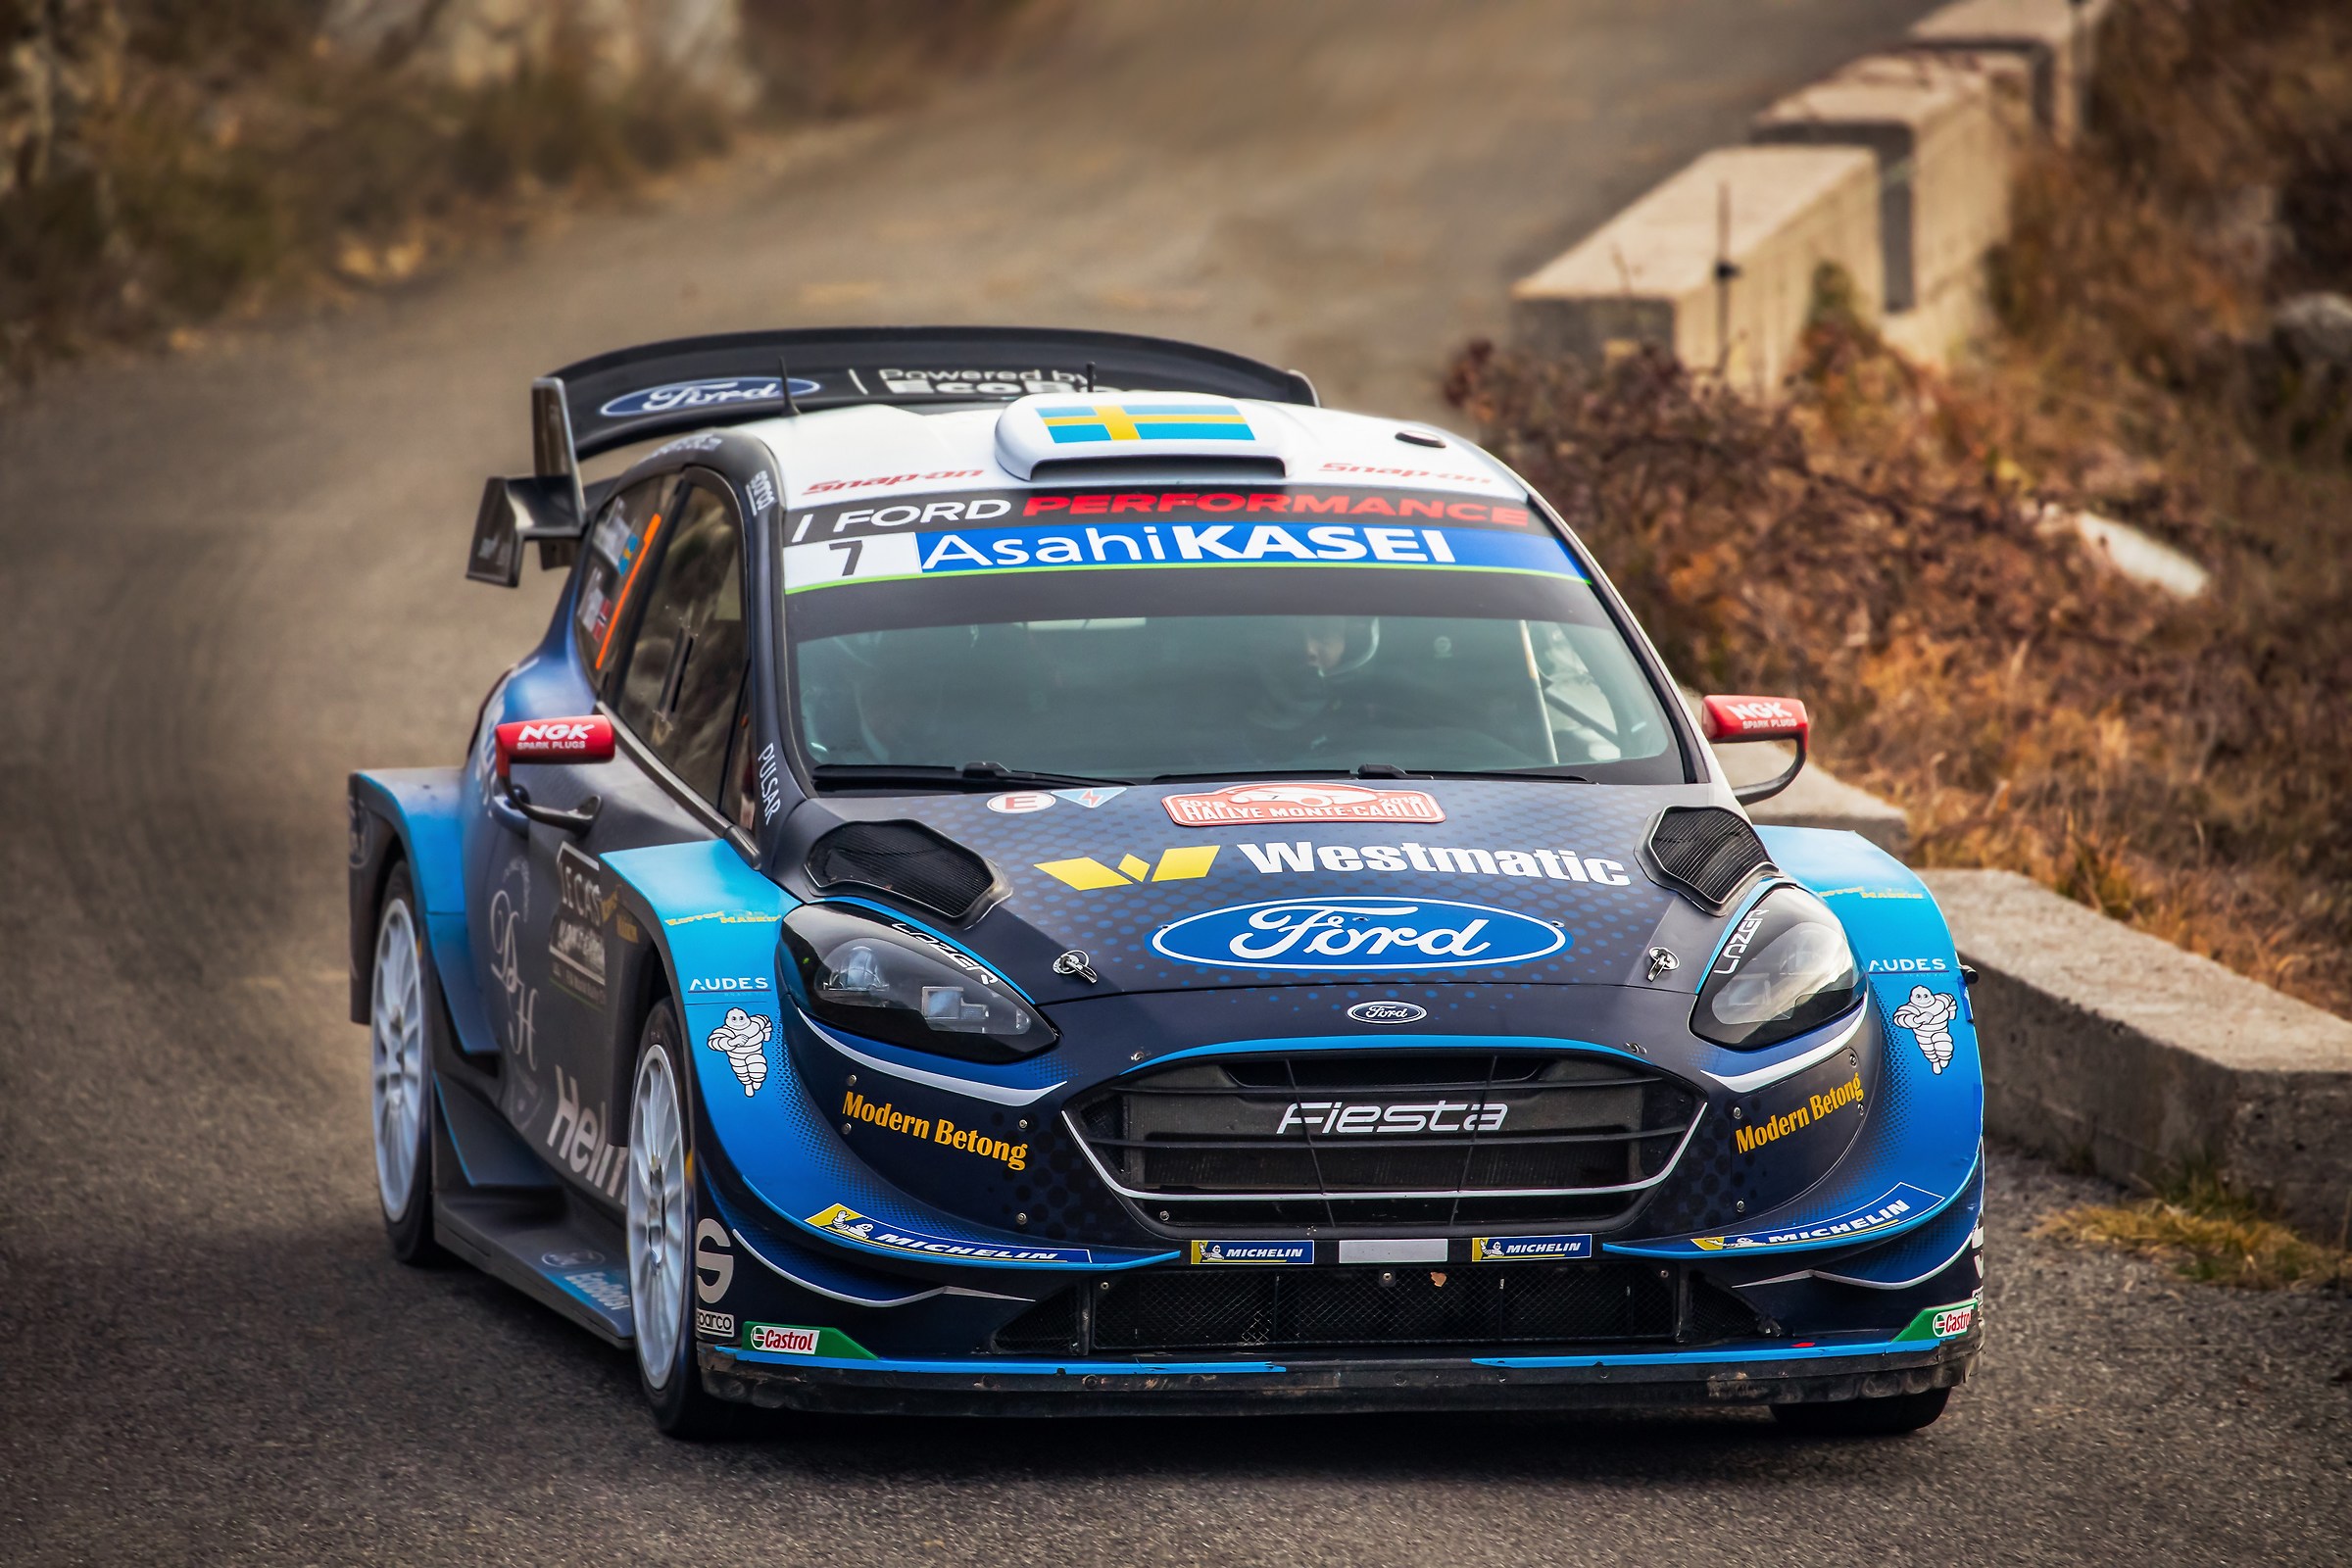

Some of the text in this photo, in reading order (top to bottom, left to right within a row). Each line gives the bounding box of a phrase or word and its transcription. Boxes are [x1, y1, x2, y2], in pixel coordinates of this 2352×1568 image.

[879, 368, 1042, 381] Powered
[642, 382, 781, 411] Ford
[802, 469, 984, 496] Snap-on
[833, 493, 1529, 533] FORD PERFORMANCE
[828, 540, 863, 577] 7
[1725, 701, 1792, 720] NGK
[518, 723, 595, 741] NGK
[1742, 717, 1797, 730] SPARK PLUGS
[516, 740, 586, 751] SPARK PLUGS
[758, 743, 782, 826] PULSAR
[1004, 795, 1038, 810] E
[1181, 801, 1431, 820] RALLYE MONTE-CARLO
[1237, 840, 1632, 886] Westmatic
[1229, 905, 1492, 959] Ford
[1868, 958, 1946, 971] AUDES
[689, 977, 769, 991] AUDES
[1365, 1001, 1409, 1018] Ford
[1276, 1100, 1508, 1134] Fiesta
[1736, 1071, 1865, 1154] Modern Betong
[842, 1091, 1028, 1171] Modern Betong
[1767, 1199, 1911, 1244] MICHELIN
[875, 1233, 1058, 1260] MICHELIN
[1225, 1248, 1303, 1257] MICHELIN
[1505, 1242, 1582, 1253] MICHELIN
[697, 1312, 733, 1331] parco
[1946, 1311, 1972, 1333] Castro
[764, 1329, 814, 1351] Castrol
